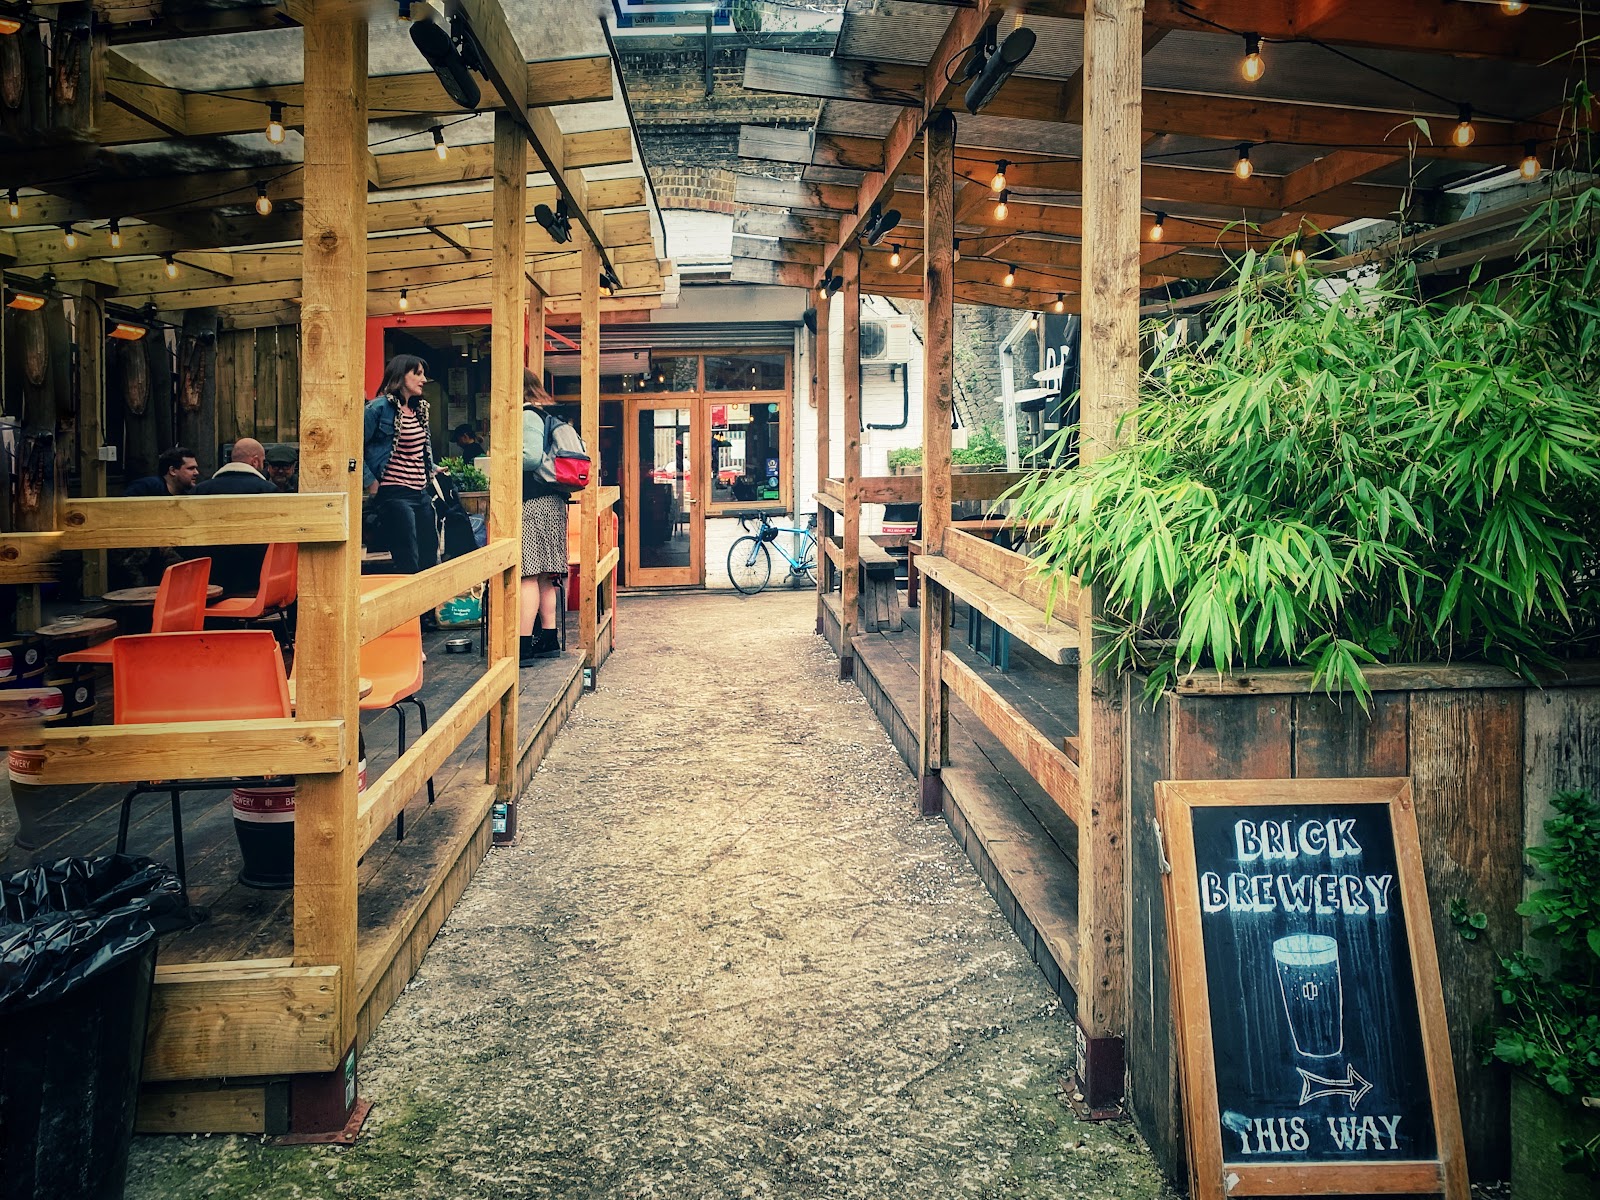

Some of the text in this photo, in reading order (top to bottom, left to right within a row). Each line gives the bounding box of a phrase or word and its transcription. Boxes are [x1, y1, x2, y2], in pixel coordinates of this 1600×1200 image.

[1235, 819, 1363, 861] BRICK
[1201, 872, 1393, 915] BREWERY
[1234, 1115, 1402, 1154] THIS WAY
